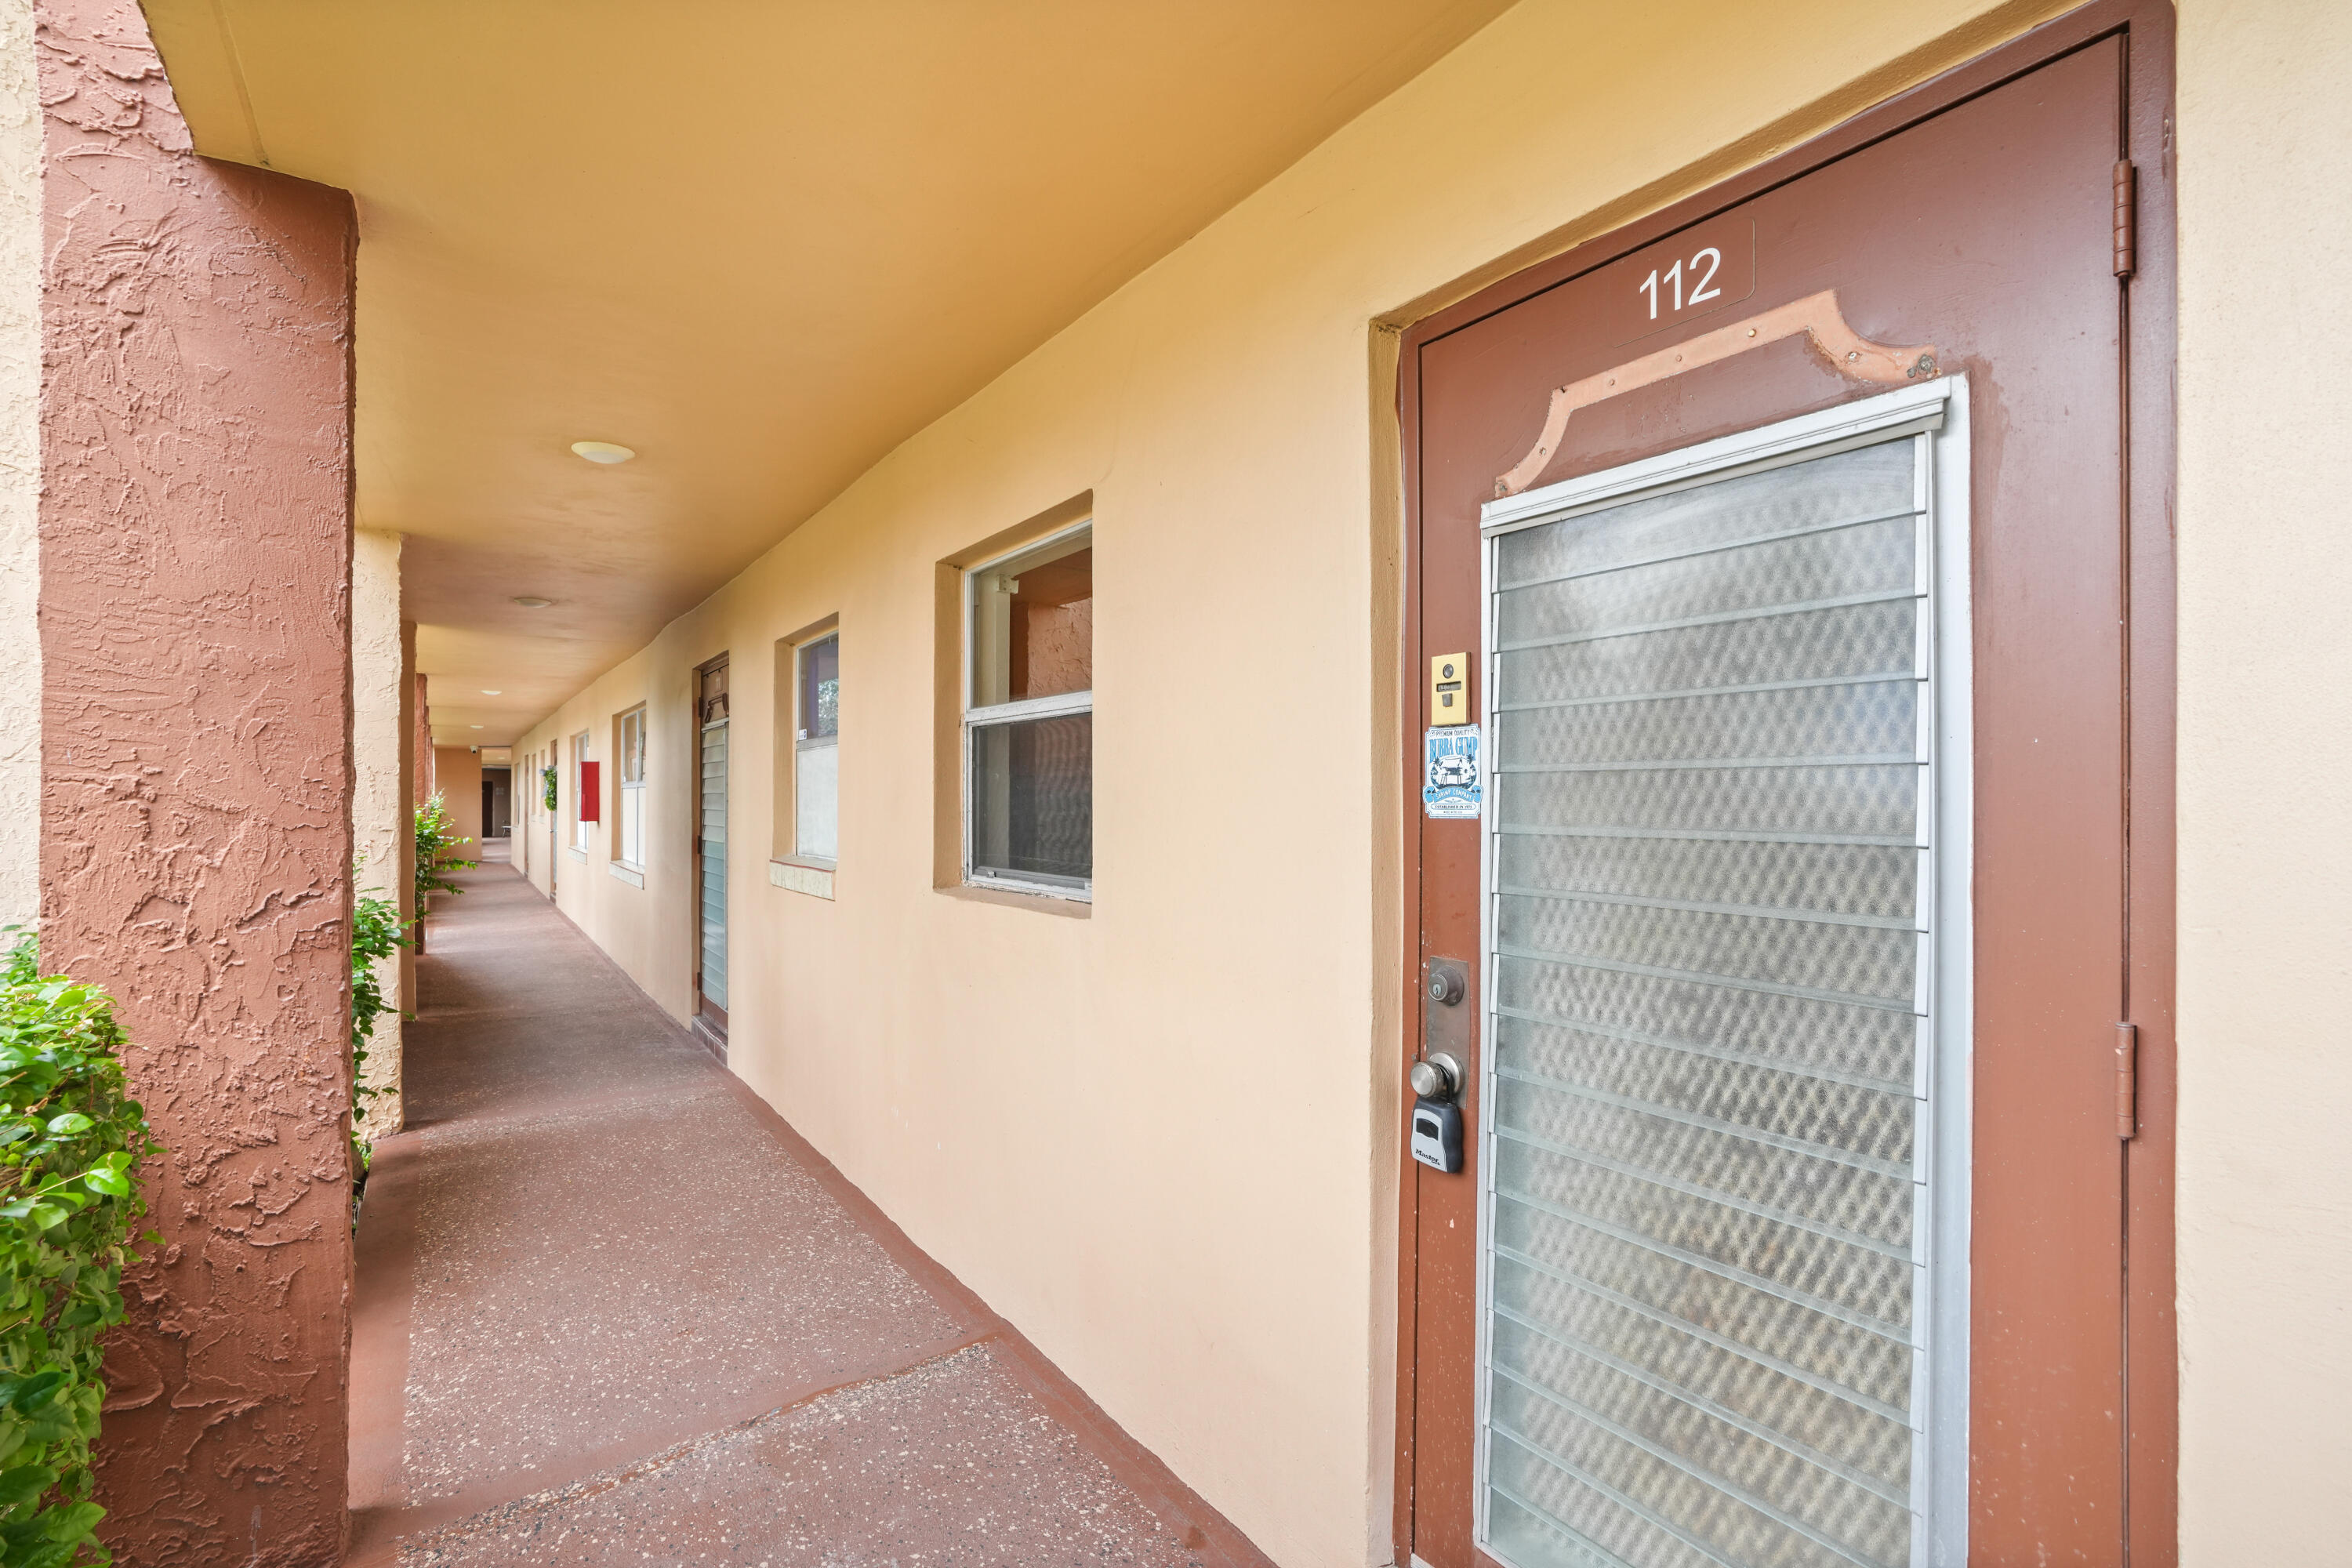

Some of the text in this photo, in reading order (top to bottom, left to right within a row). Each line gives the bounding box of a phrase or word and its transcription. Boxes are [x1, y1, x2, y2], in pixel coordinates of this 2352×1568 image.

[1639, 247, 1721, 320] 112
[1429, 736, 1478, 763] BUBBA GUMP
[1436, 789, 1472, 800] SHRIMP COMPANY
[1415, 1148, 1439, 1163] Master
